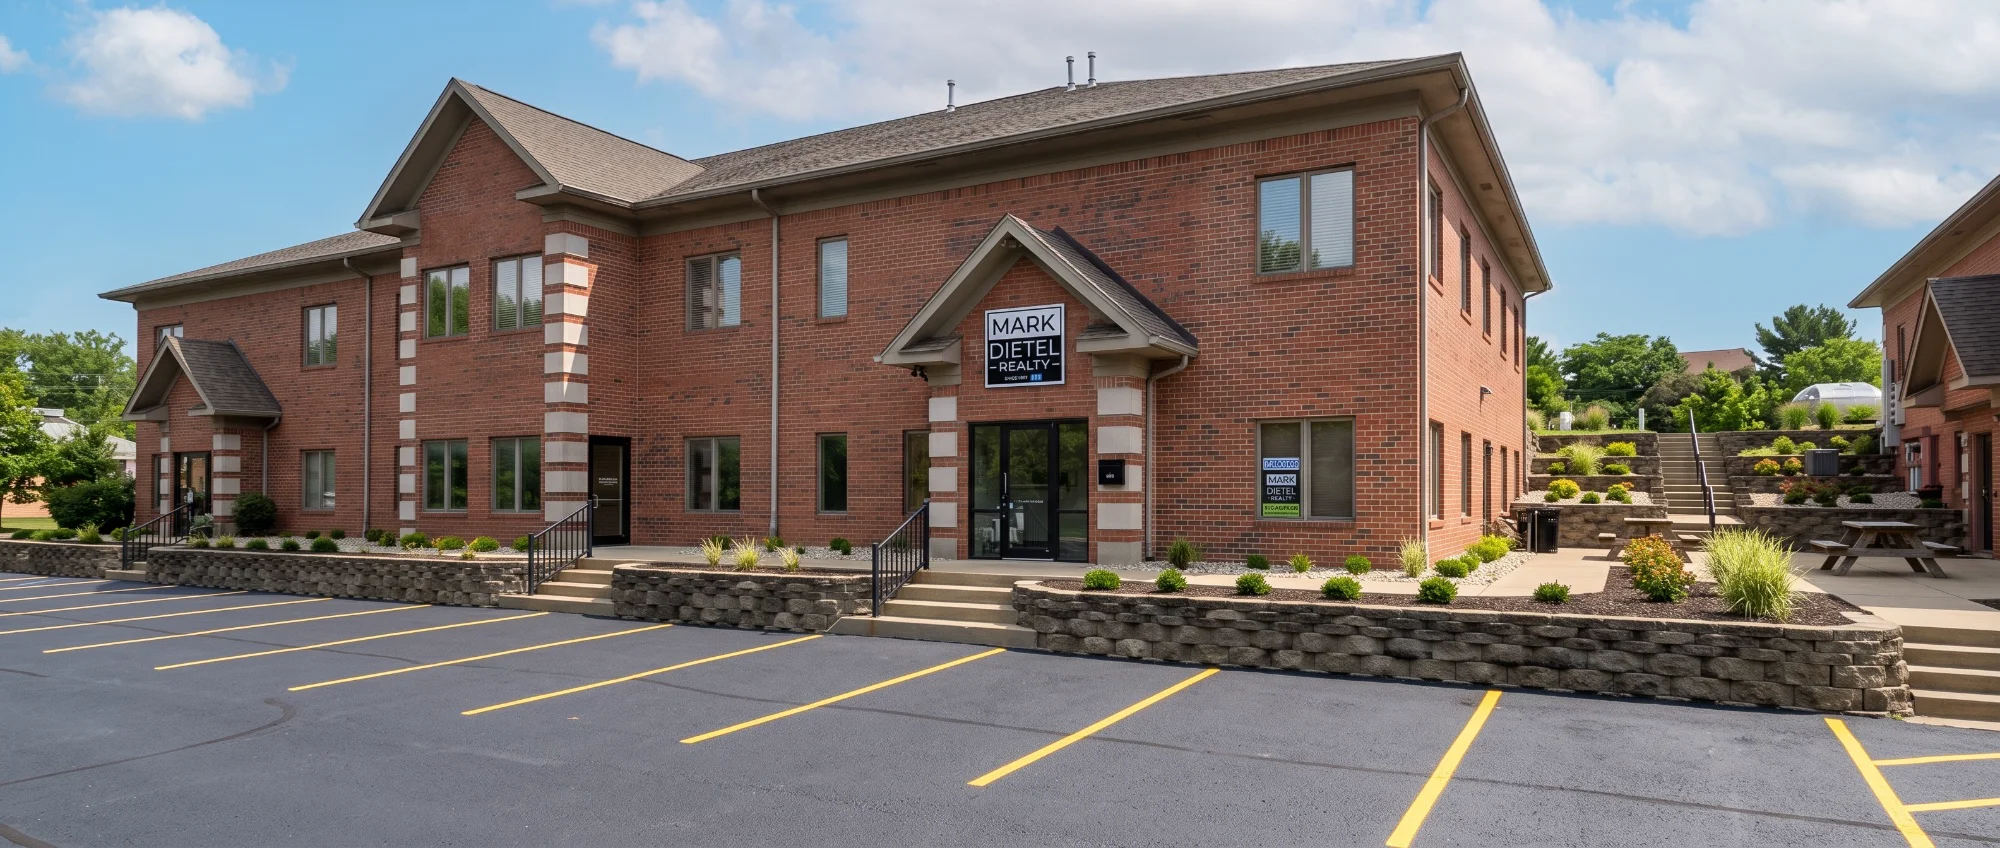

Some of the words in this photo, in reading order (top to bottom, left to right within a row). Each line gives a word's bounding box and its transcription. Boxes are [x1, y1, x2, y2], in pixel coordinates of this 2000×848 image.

[993, 314, 1055, 335] MARK
[990, 339, 1060, 360] DIETEL
[999, 359, 1051, 372] REALTY
